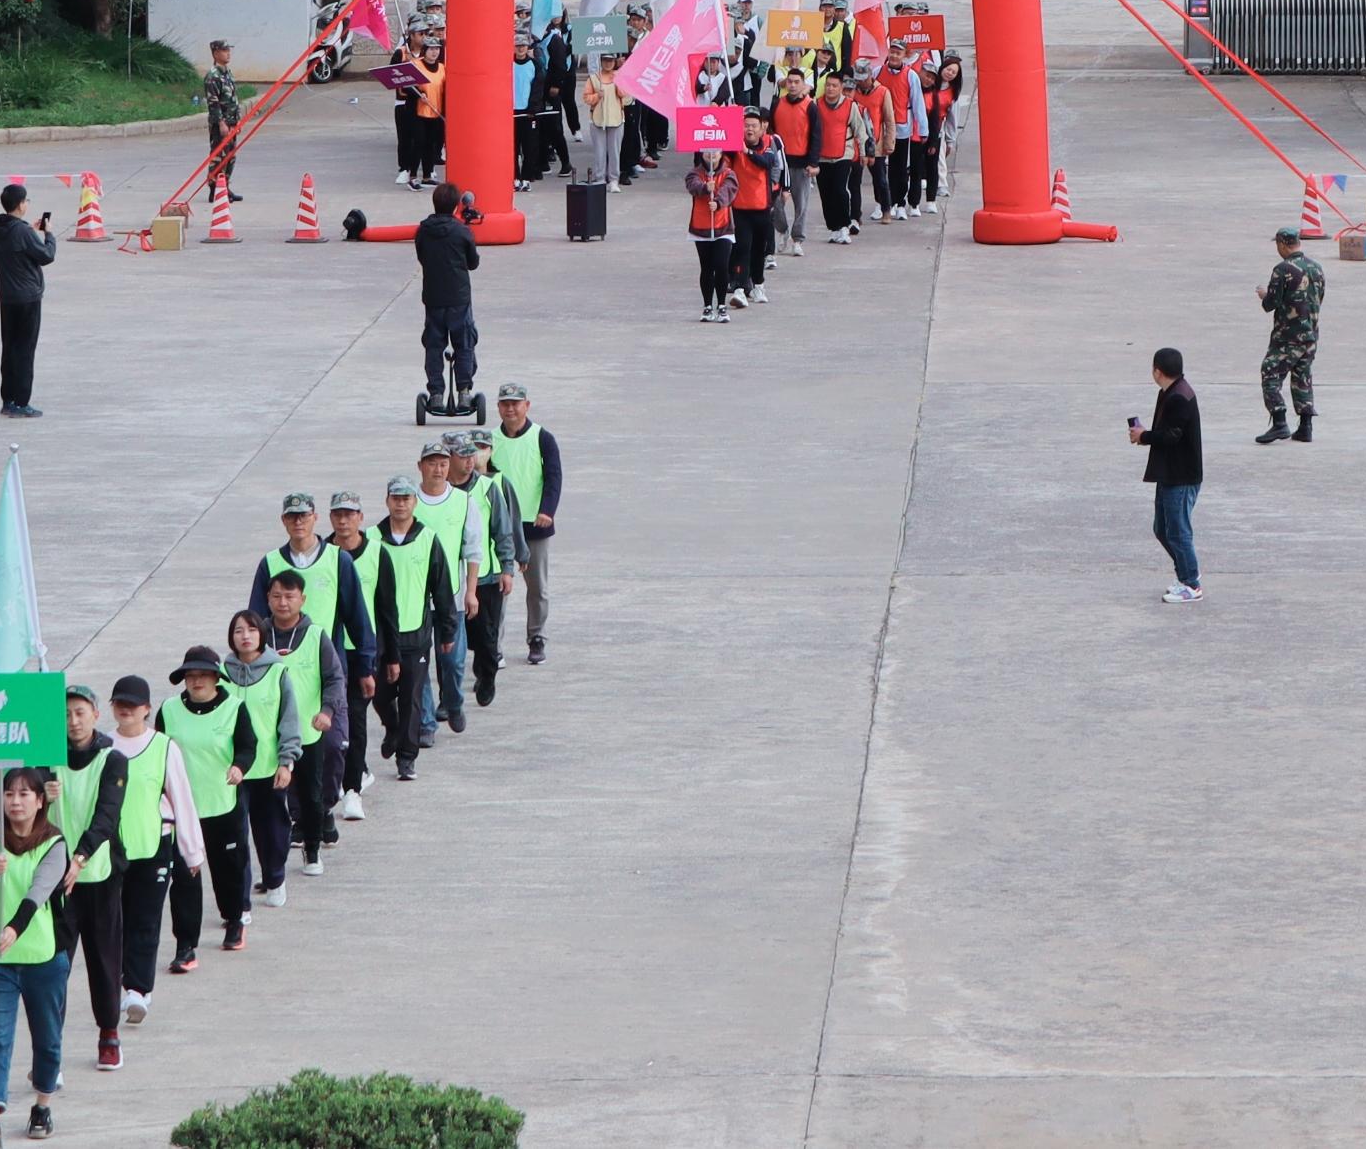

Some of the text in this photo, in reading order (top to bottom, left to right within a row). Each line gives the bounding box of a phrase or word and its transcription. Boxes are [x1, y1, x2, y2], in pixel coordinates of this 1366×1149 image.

[586, 35, 614, 47] 公牛队
[693, 129, 727, 141] 黑马队
